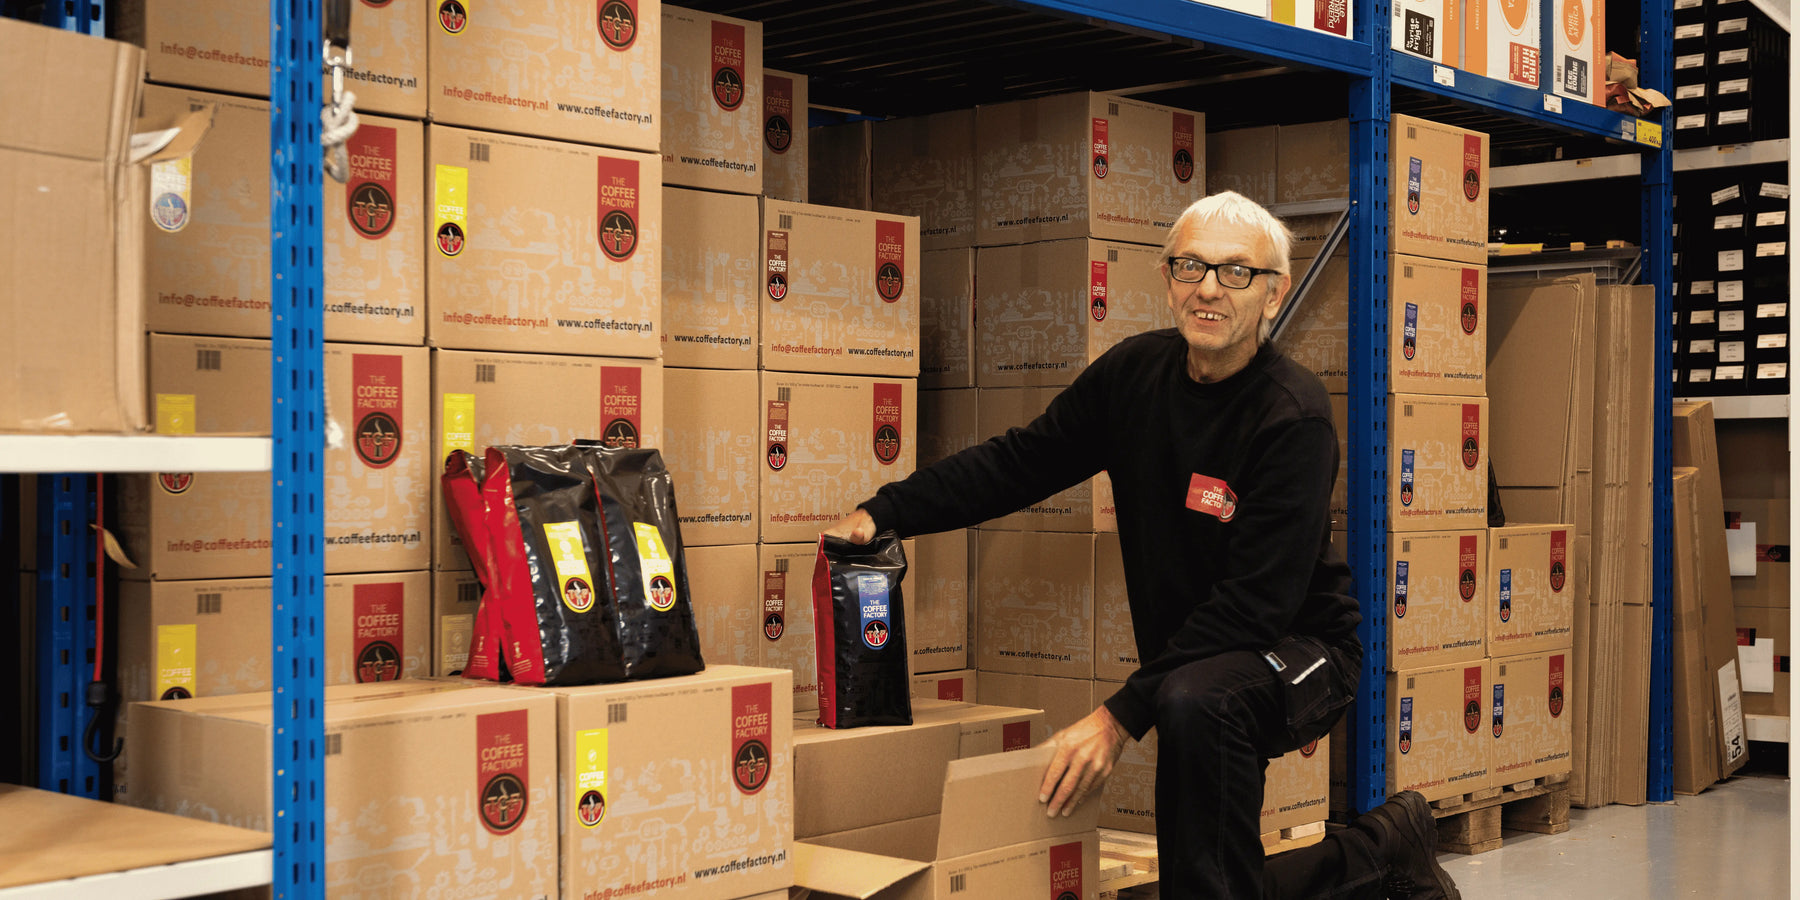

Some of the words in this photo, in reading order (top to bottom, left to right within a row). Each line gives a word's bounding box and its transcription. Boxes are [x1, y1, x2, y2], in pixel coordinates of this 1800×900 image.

[723, 38, 733, 47] THE
[715, 45, 742, 59] COFFEE
[715, 56, 742, 67] FACTORY
[443, 86, 549, 111] info@coffeefactory.nl
[558, 102, 652, 124] www.coffeefactory.nl
[767, 96, 790, 107] COFFEE
[1174, 132, 1192, 141] COFFEE
[363, 145, 380, 156] THE
[352, 155, 392, 171] COFFEE
[681, 155, 756, 173] www.coffeefactory.nl
[352, 168, 391, 181] FACTORY
[612, 176, 625, 186] THE
[601, 185, 636, 199] COFFEE
[601, 197, 635, 209] FACTORY
[997, 214, 1069, 228] www.coffeefactory.nl
[879, 243, 901, 253] COFFEE
[879, 252, 901, 261] FACTORY
[443, 312, 549, 328] info@coffeefactory.nl
[558, 318, 653, 332] www.coffeefactory.nl
[675, 333, 751, 346] www.coffeefactory.nl
[771, 343, 842, 356] info@coffeefactory.nl
[848, 347, 914, 358] www.coffeefactory.nl
[998, 361, 1067, 371] www.coffeefactory.nl
[370, 376, 385, 385] THE
[357, 386, 398, 397] COFFEE
[614, 386, 628, 394] THE
[358, 399, 398, 408] FACTORY
[604, 395, 637, 407] COFFEE
[604, 407, 637, 416] FACTORY
[876, 405, 899, 415] COFFEE
[876, 415, 899, 423] FACTORY
[1213, 486, 1223, 494] THE
[771, 512, 840, 523] info@coffeefactory.nl
[371, 604, 386, 613] THE
[766, 599, 783, 607] COFFEE
[358, 614, 399, 627] COFFEE
[358, 627, 398, 638] FACTORY
[1000, 650, 1071, 661] www.coffeefactory.nl
[746, 705, 759, 713] THE
[736, 713, 768, 728] COFFEE
[736, 725, 768, 738] FACTORY
[495, 734, 511, 744] THE
[481, 744, 523, 761] COFFEE
[481, 758, 523, 772] FACTORY
[695, 850, 786, 879] www.coffeefactory.nl
[1062, 860, 1073, 870] THE
[1053, 868, 1079, 882] COFFEE
[1054, 879, 1079, 890] FACTORY
